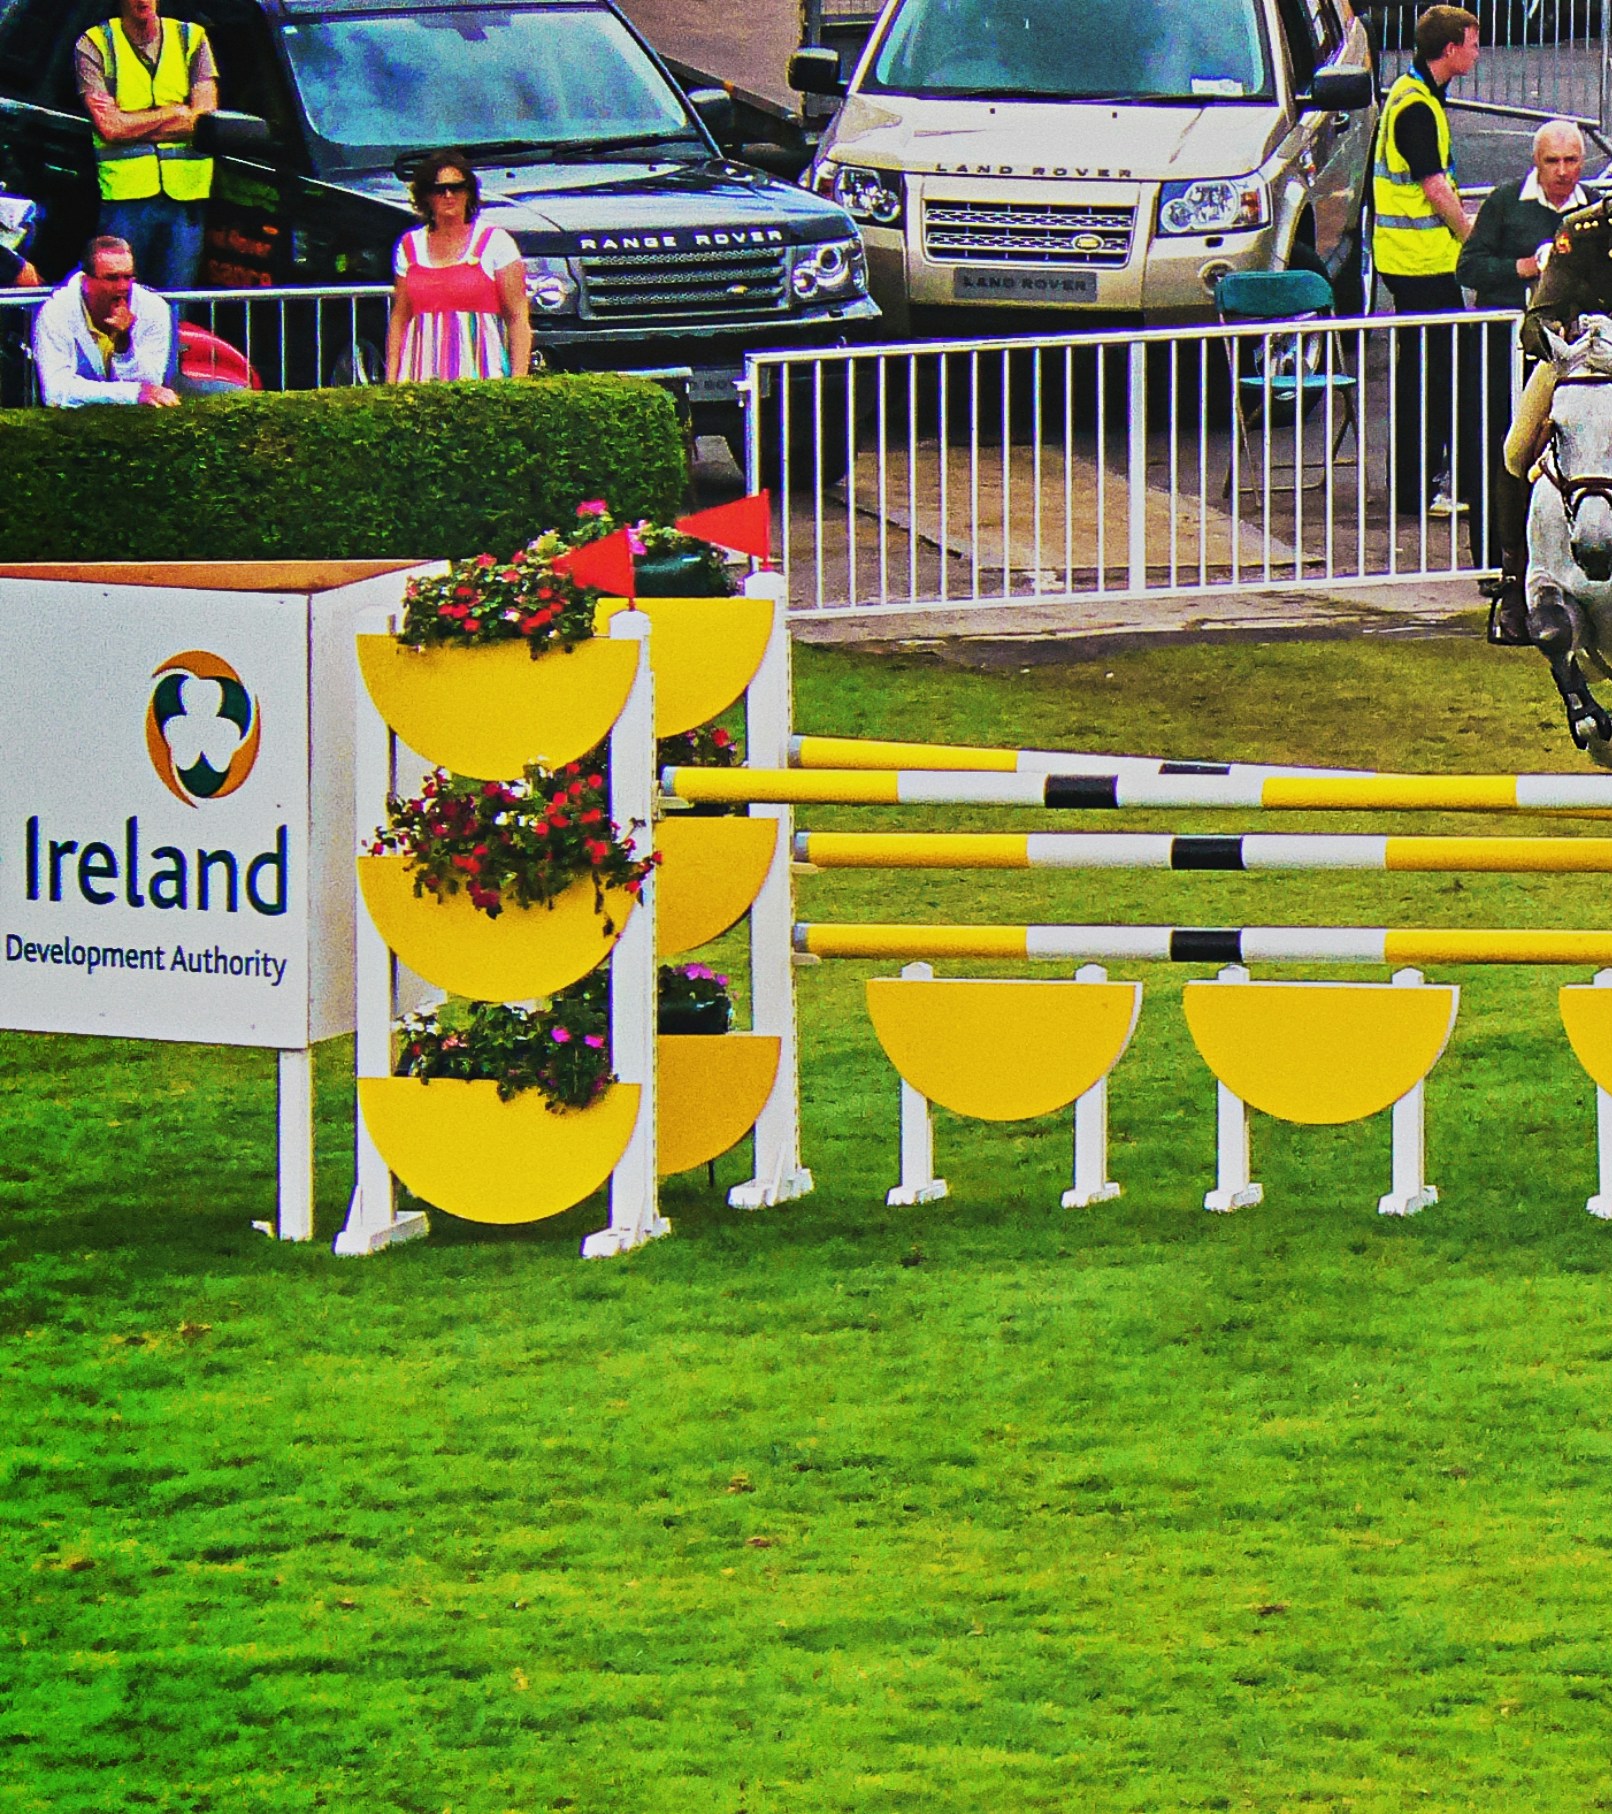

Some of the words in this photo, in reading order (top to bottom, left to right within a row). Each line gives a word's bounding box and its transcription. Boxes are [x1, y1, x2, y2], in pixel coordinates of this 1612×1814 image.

[935, 163, 1013, 174] LAND
[1032, 167, 1132, 178] ROVER
[580, 236, 677, 249] RANGE
[695, 229, 783, 245] ROVER
[963, 276, 1014, 288] LAND
[1021, 278, 1087, 291] ROVER
[26, 815, 288, 916] Ireland
[6, 933, 166, 975] Development
[170, 944, 287, 986] Authority
